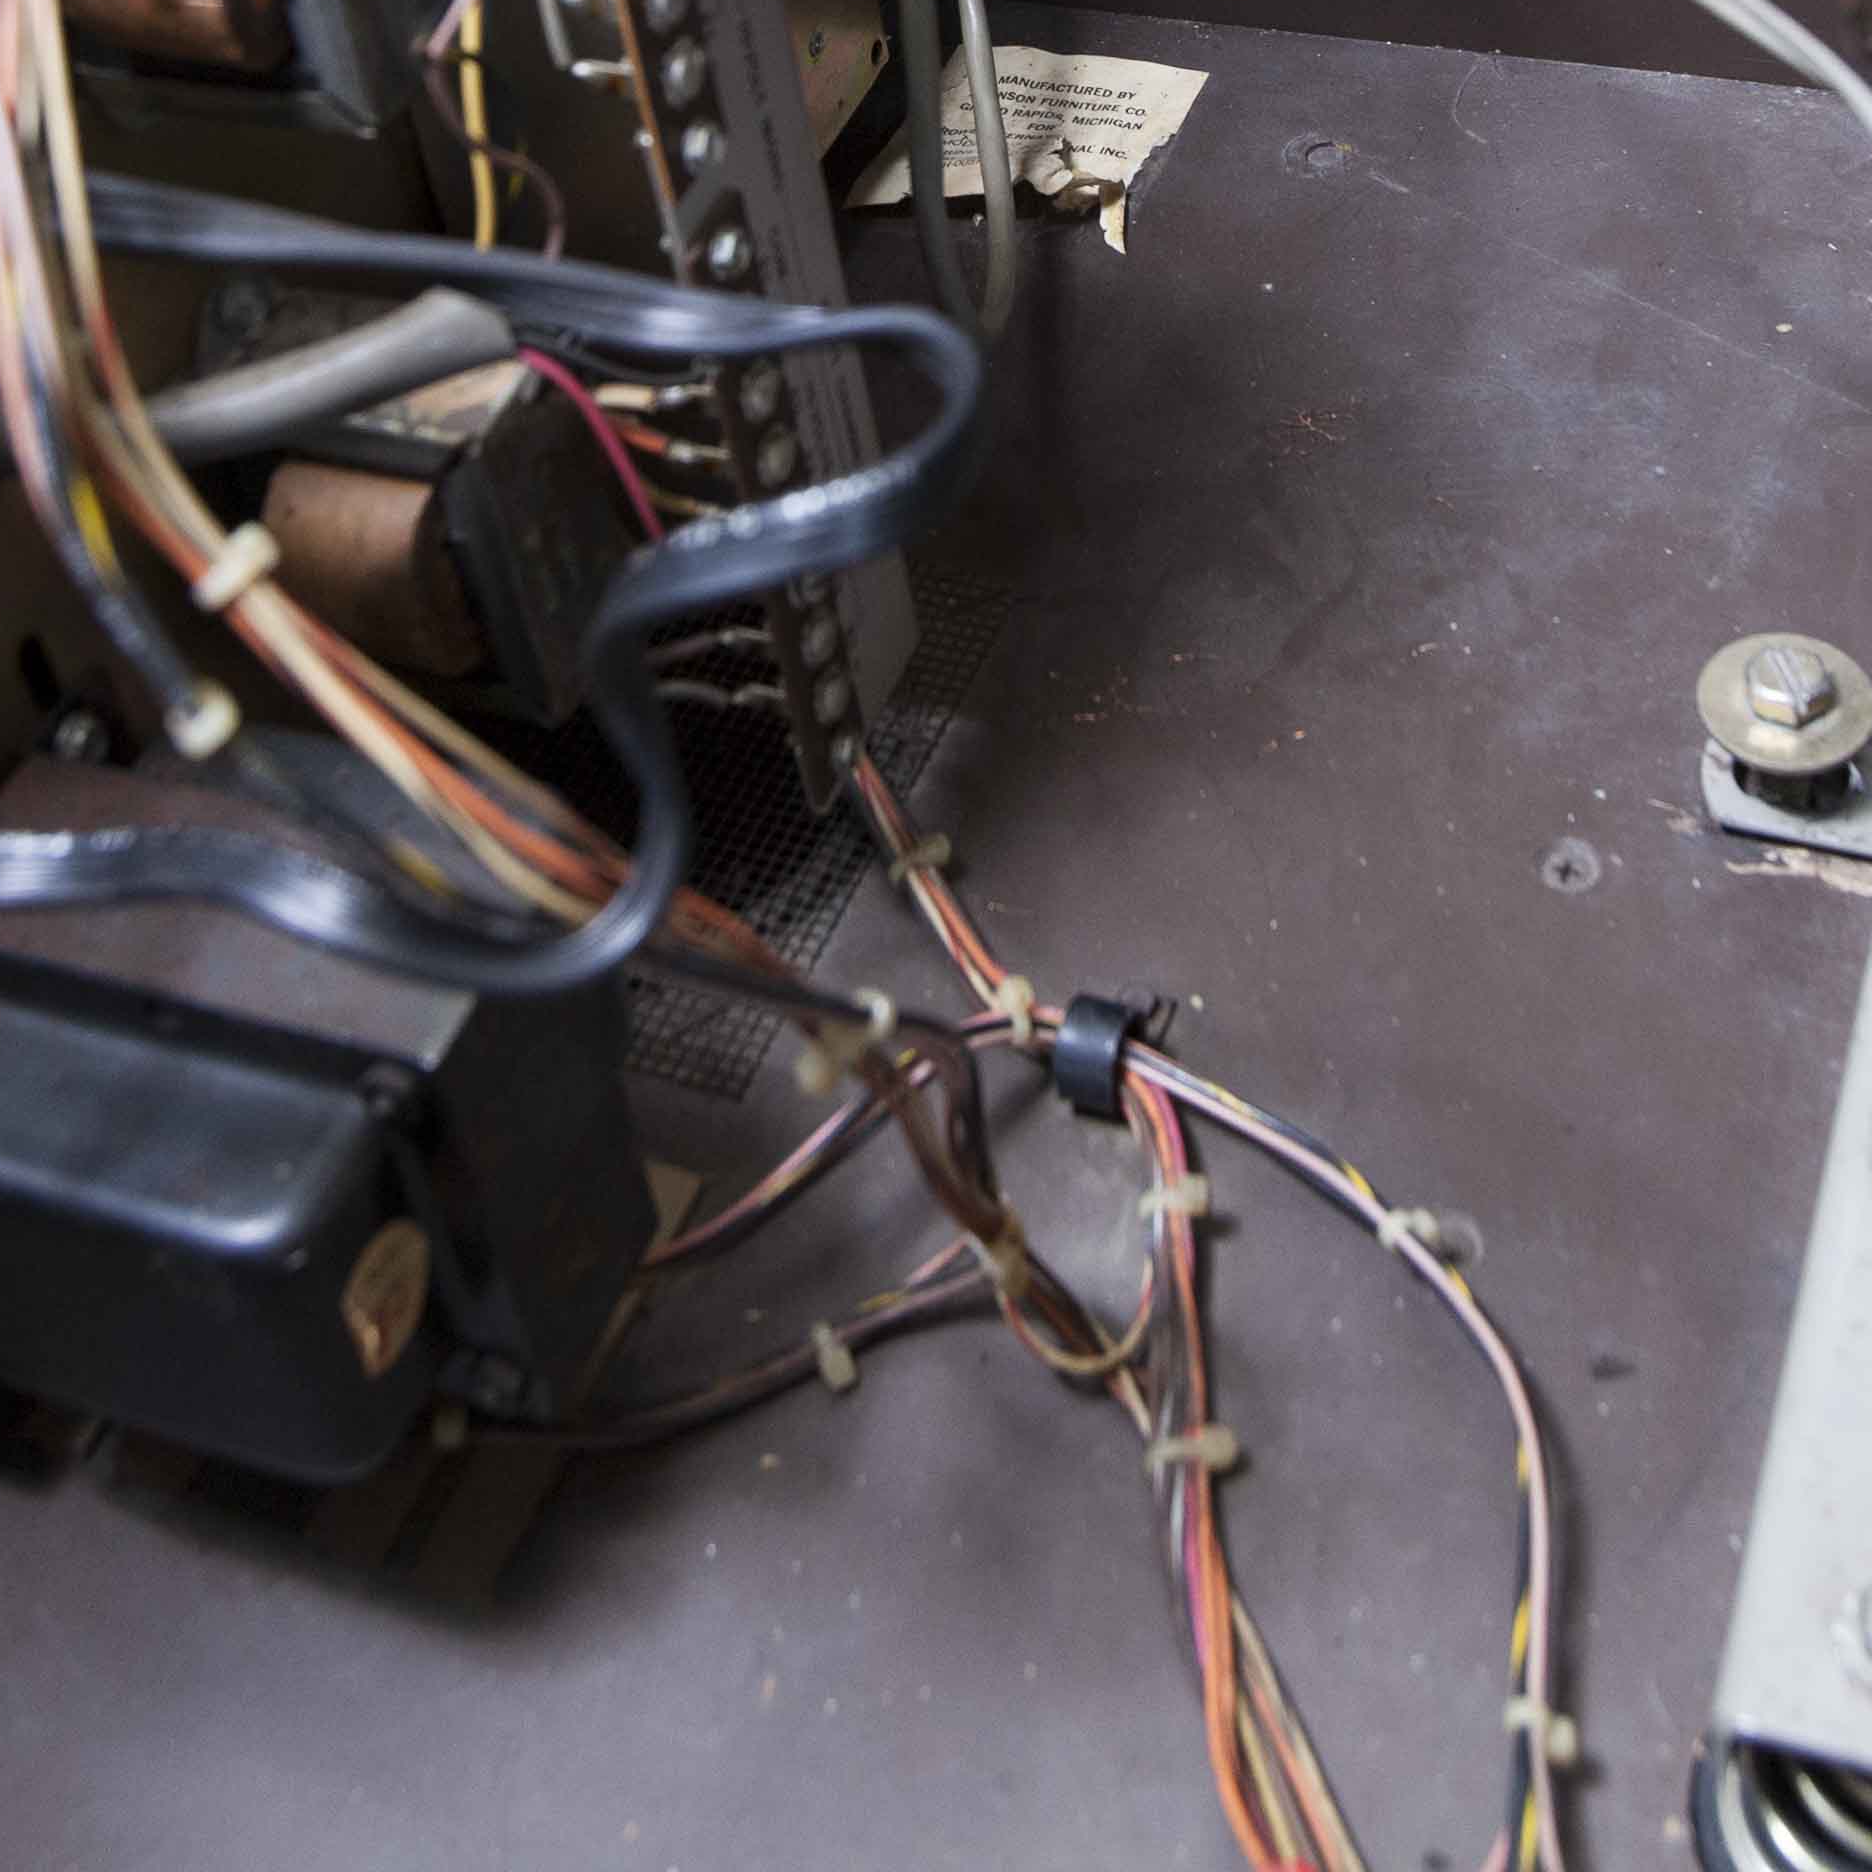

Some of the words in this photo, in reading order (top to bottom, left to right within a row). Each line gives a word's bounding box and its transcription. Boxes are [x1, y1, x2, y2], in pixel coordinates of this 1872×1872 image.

[998, 74, 1113, 98] MANUFACTURED
[1117, 88, 1137, 101] BY
[1040, 97, 1120, 113] FURNITURE
[1027, 121, 1057, 132] FOR
[1071, 114, 1144, 131] MICHIGAN
